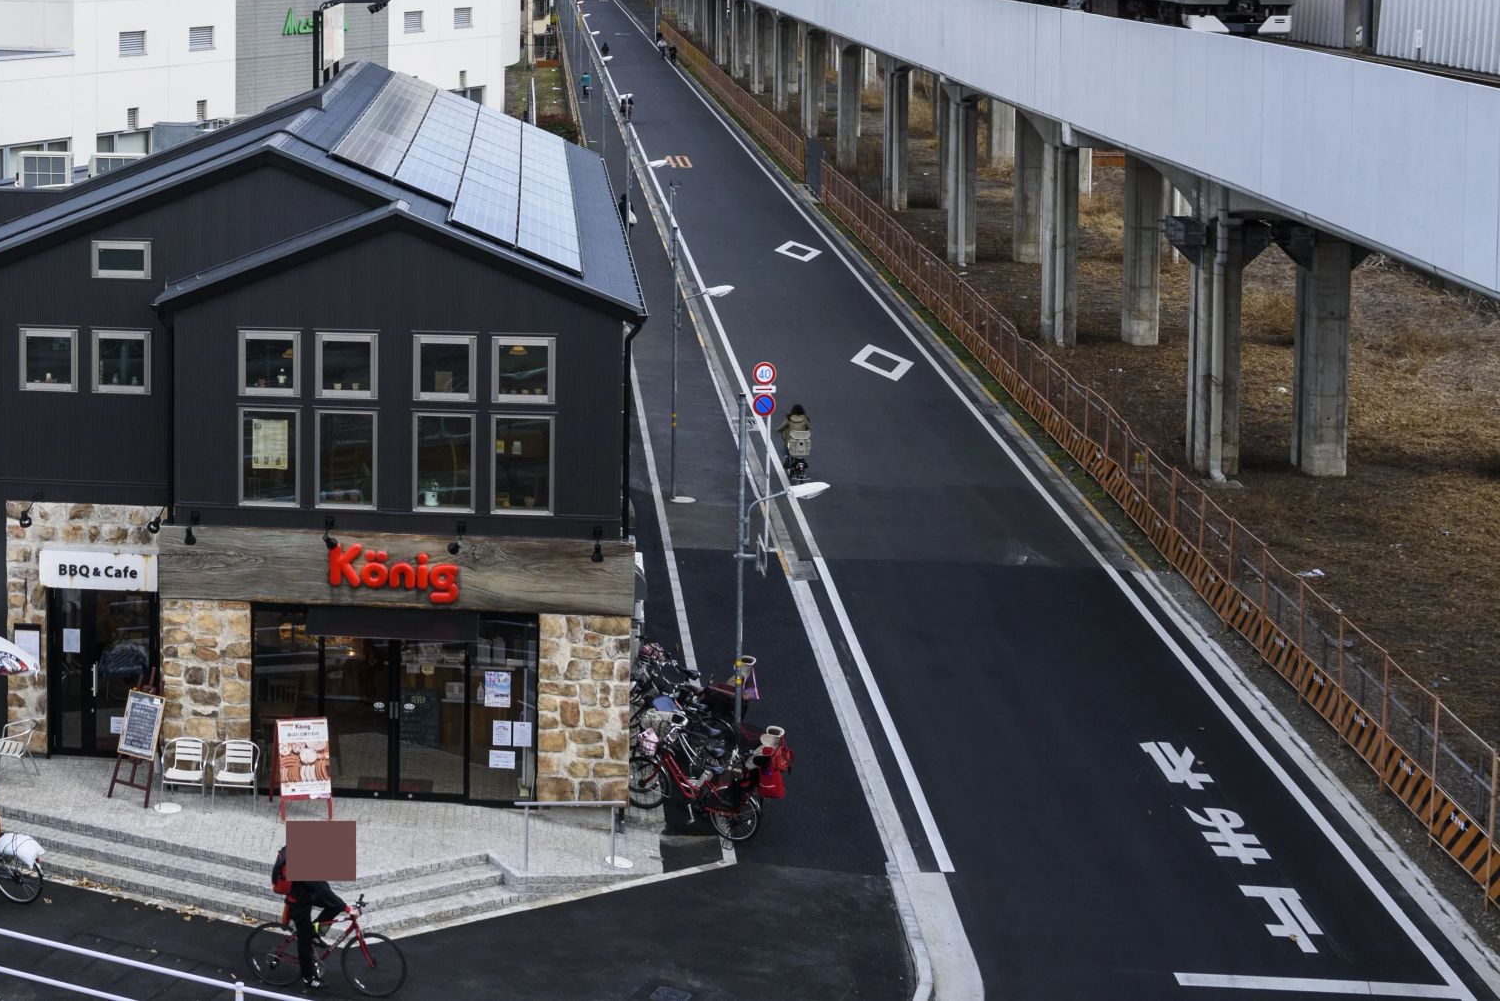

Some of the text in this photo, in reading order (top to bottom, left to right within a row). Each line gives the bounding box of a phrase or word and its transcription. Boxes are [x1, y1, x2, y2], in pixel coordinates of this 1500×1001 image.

[758, 368, 771, 379] 40
[58, 564, 138, 579] BBQ & Cafe
[329, 543, 460, 604] König
